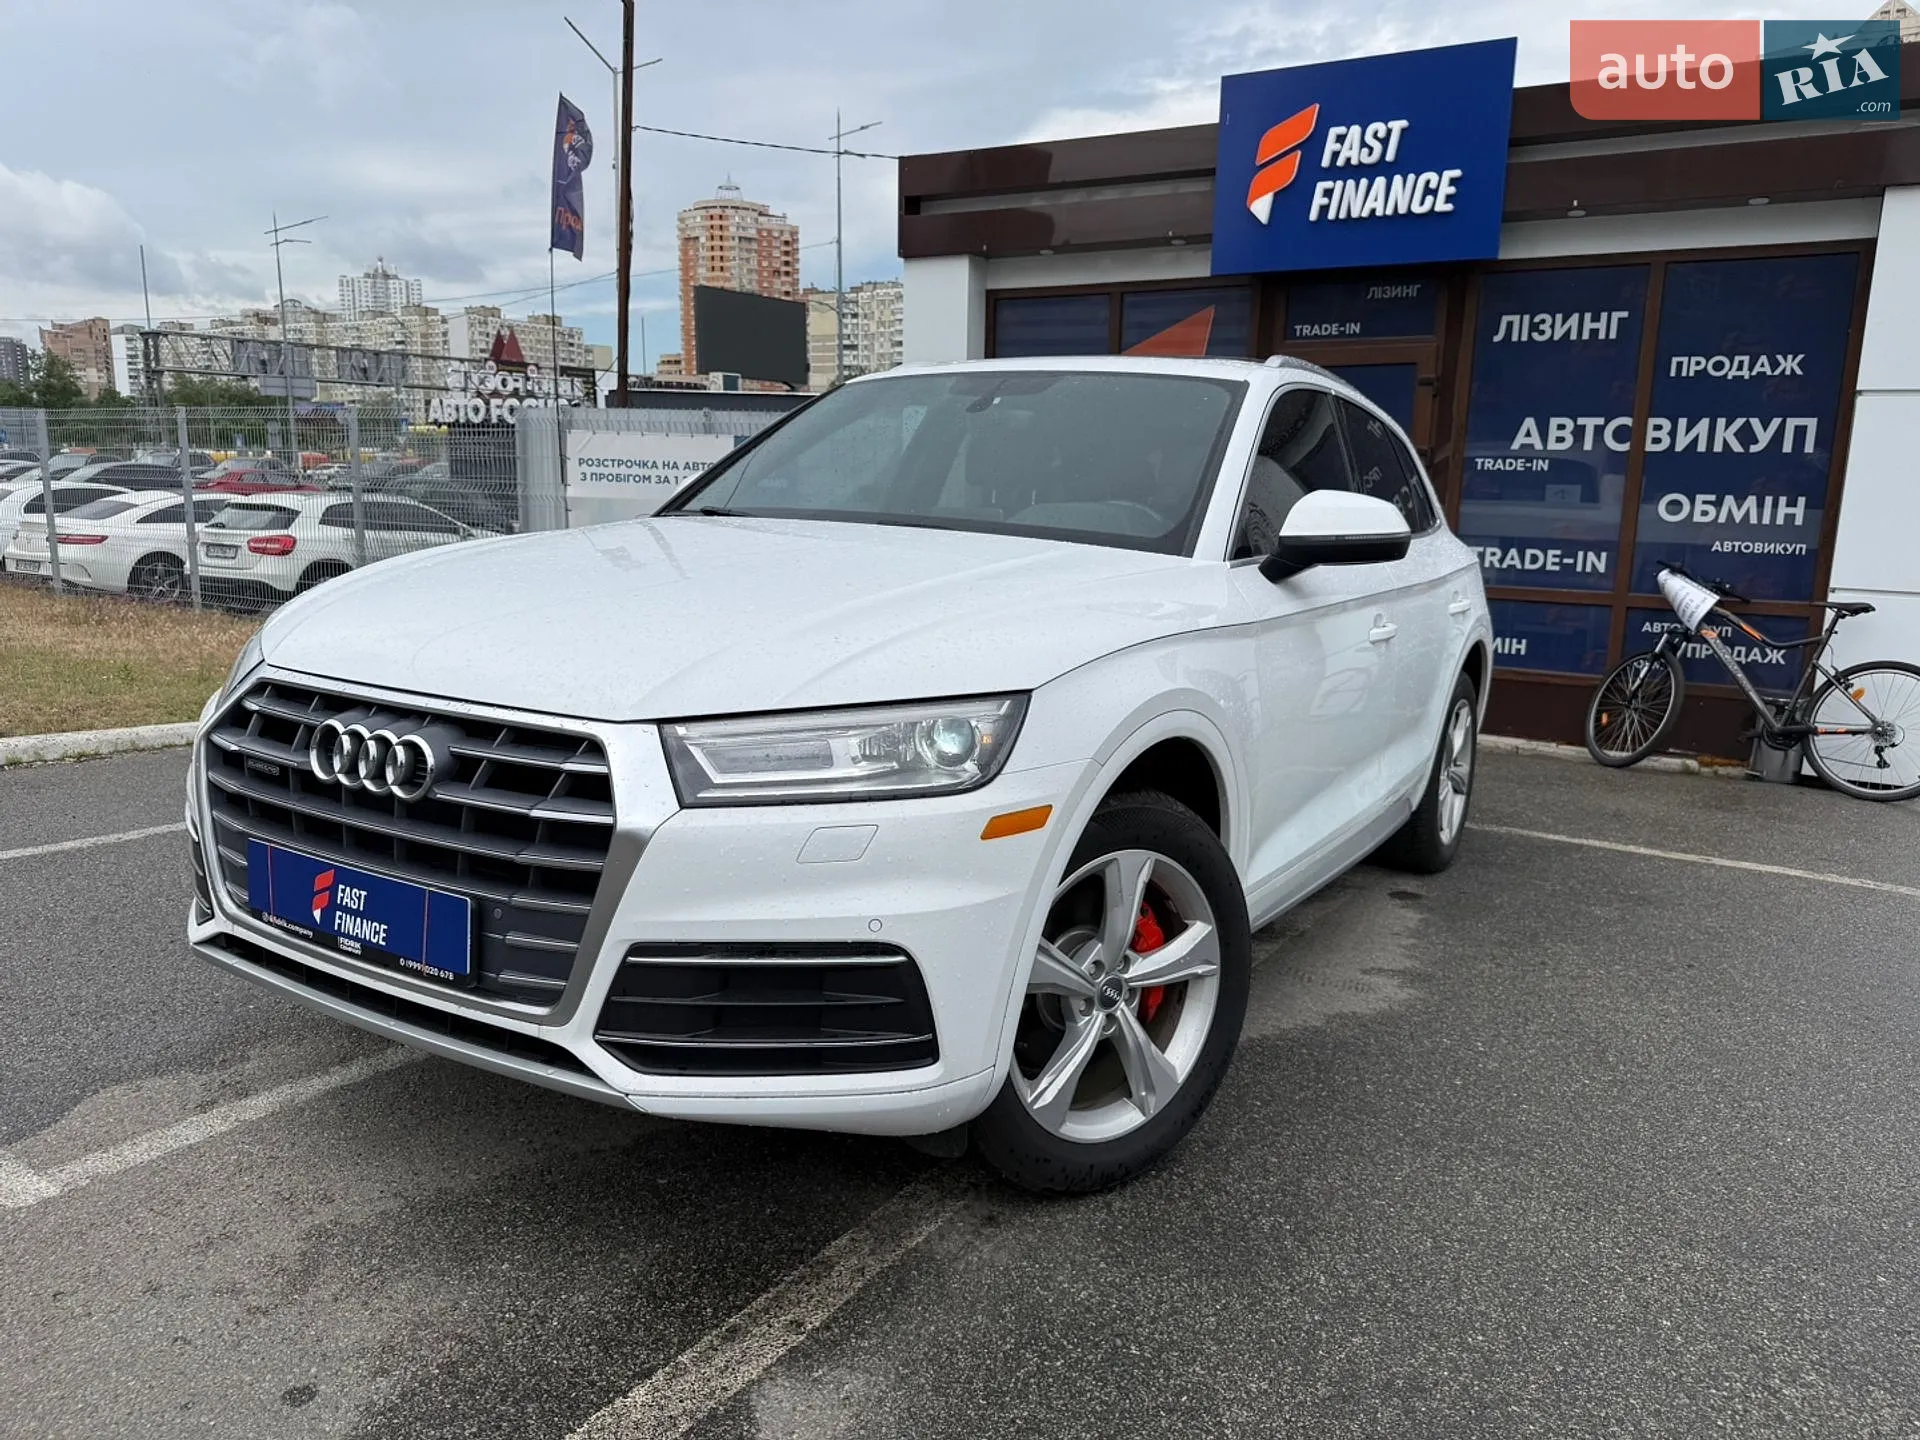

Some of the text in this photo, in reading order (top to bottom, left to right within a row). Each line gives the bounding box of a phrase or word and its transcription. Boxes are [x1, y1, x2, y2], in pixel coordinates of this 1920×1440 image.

[1320, 119, 1408, 167] FAST
[1309, 169, 1463, 222] FINANCE
[1367, 284, 1421, 300] ЛІЗИНГ
[1294, 322, 1361, 337] TRADE-IN
[1493, 311, 1629, 342] ЛІЗИНГ
[1669, 353, 1805, 380] ПРОДАЖ
[1510, 417, 1818, 453] АВТОВИКУП
[578, 458, 659, 470] РОЗСТРОЧКА
[662, 461, 680, 470] НА
[1475, 458, 1549, 472] TRADE-IN
[590, 473, 651, 484] ПРОБІГОМ
[1657, 494, 1806, 525] ОБМІН
[1710, 540, 1807, 556] АВТОВИКУП
[337, 884, 368, 911] FAST
[334, 911, 389, 946] FINANCE
